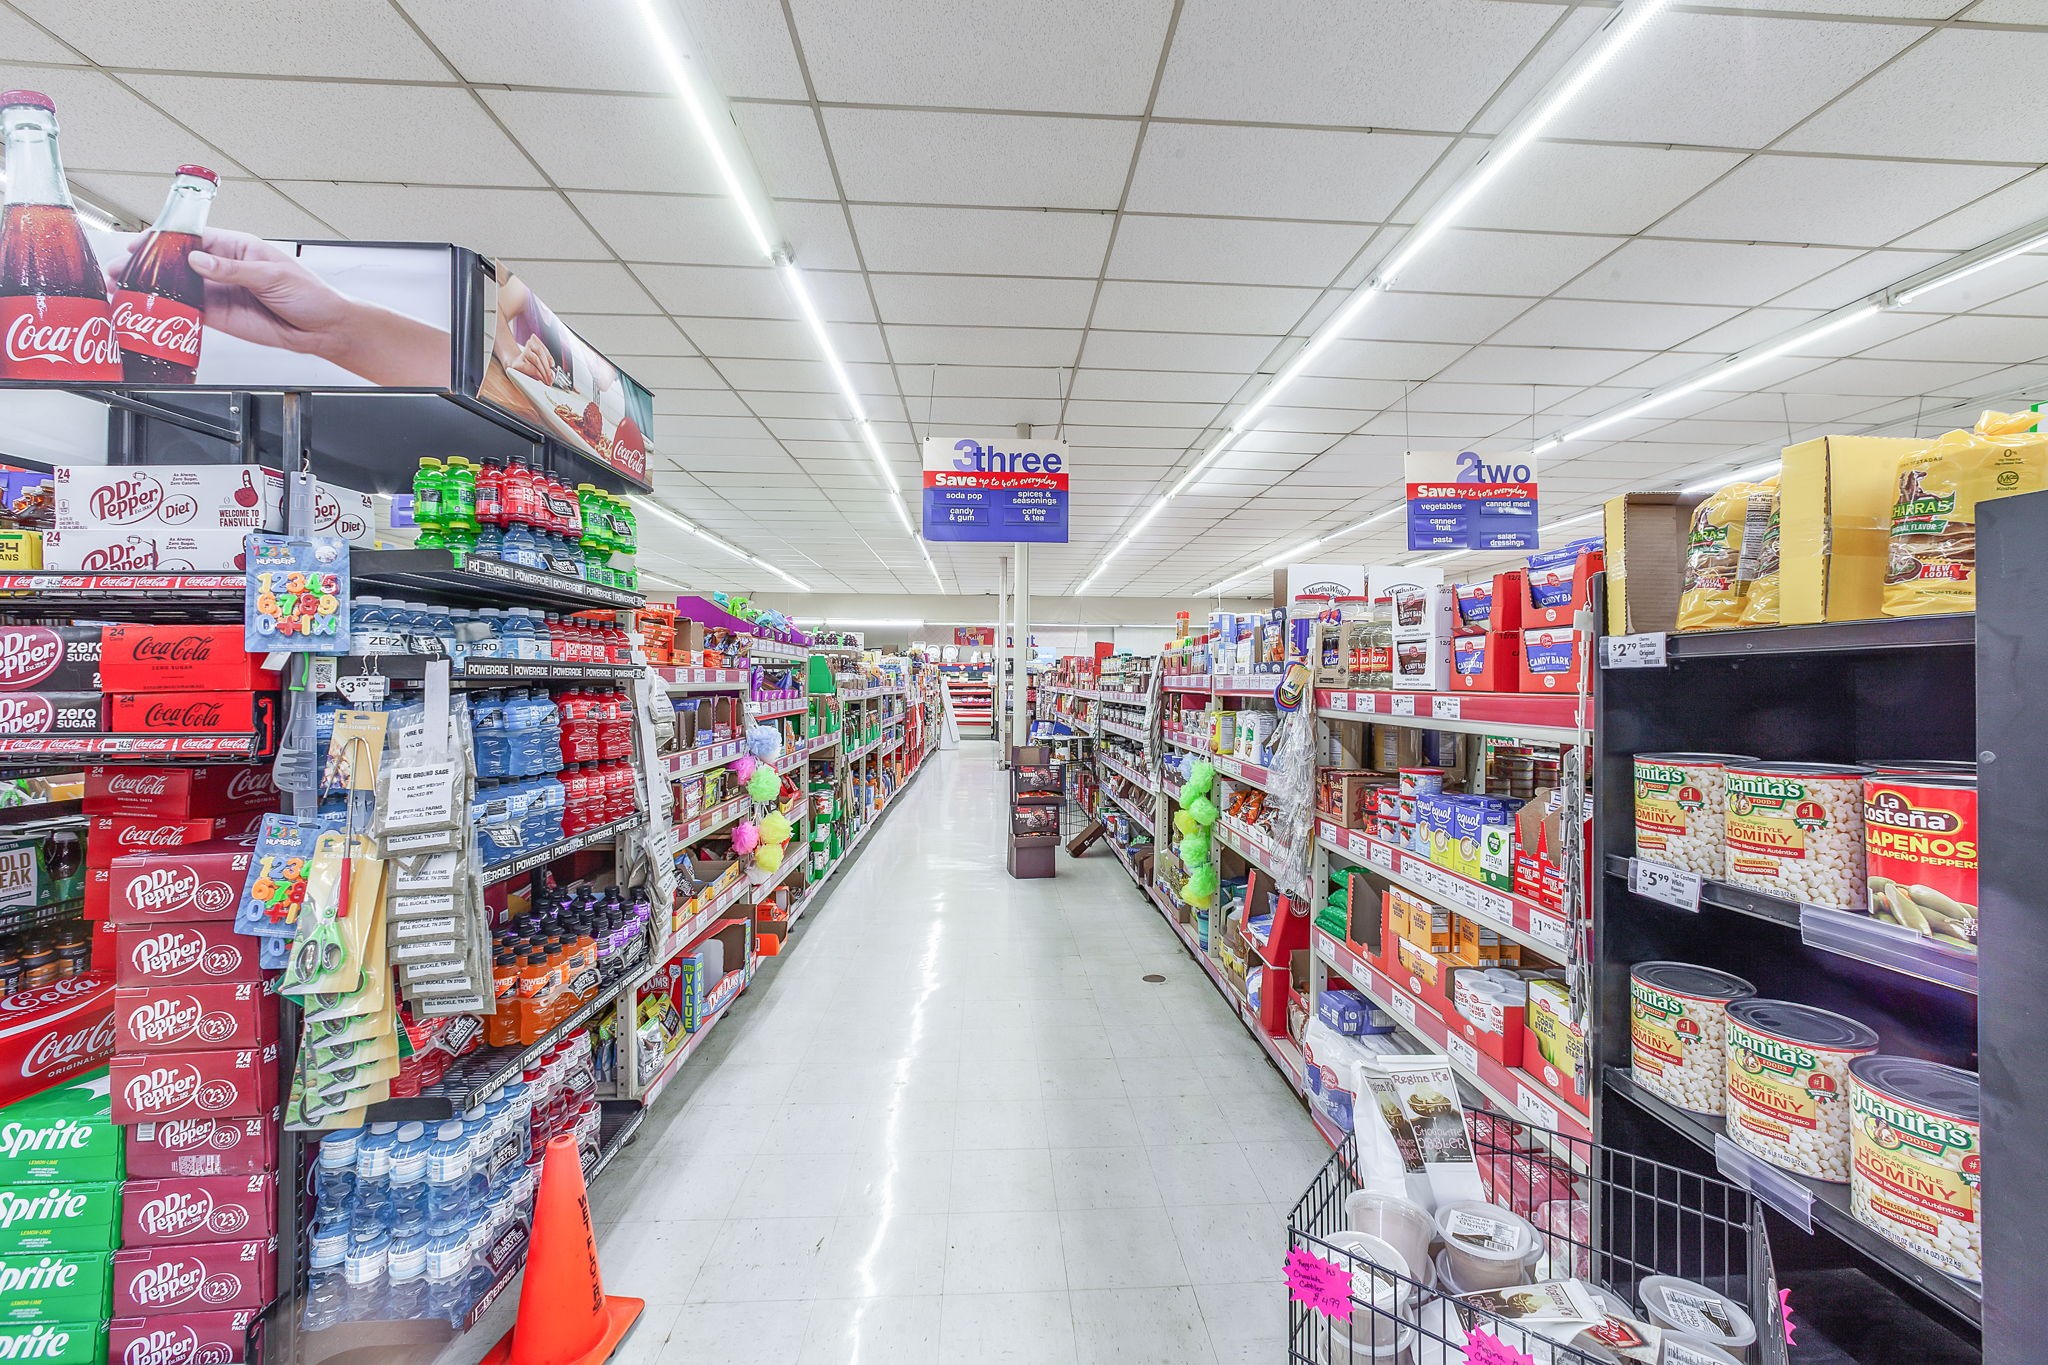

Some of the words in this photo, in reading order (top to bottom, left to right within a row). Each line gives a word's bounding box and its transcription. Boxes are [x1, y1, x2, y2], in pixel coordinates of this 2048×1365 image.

[111, 302, 201, 357] Coca-Cola
[6, 313, 121, 365] Coca-Cola
[613, 440, 646, 474] Coca-Cola
[57, 468, 70, 479] 24
[935, 473, 977, 487] Save
[978, 478, 990, 488] up
[991, 477, 1000, 486] to
[1001, 478, 1019, 487] 40%
[1020, 475, 1058, 490] everyday
[115, 480, 142, 501] Dr
[967, 493, 983, 501] pop
[1017, 491, 1043, 499] spices
[1417, 485, 1456, 497] Save
[1457, 489, 1467, 499] up
[1468, 488, 1476, 496] to
[1477, 489, 1493, 498] 40%
[1494, 485, 1528, 499] everyday
[90, 485, 159, 521] Pepper
[1012, 497, 1057, 506] seasonings
[1420, 503, 1463, 511] vegetables
[165, 502, 191, 519] Diet
[219, 510, 250, 518] WELCOME
[250, 510, 260, 518] TO
[949, 514, 956, 522] &
[957, 515, 975, 523] gum
[950, 507, 974, 516] candy
[1024, 514, 1031, 522] &
[219, 518, 260, 527] FANSVILLE
[341, 519, 361, 533] Diet
[46, 531, 61, 543] 24
[1432, 537, 1453, 545] pasta
[1490, 539, 1525, 548] dressings
[1924, 570, 1953, 578] LOOK!
[109, 629, 125, 637] 24
[133, 636, 215, 662] Coca-Cola
[472, 643, 498, 651] ZERO
[468, 664, 509, 676] POWERADE
[1529, 656, 1550, 667] CANDY
[1551, 656, 1570, 666] BARK
[514, 665, 549, 677] POWERADE
[552, 667, 582, 677] POWERADE
[120, 695, 135, 703] 24
[57, 708, 97, 719] zero
[145, 703, 221, 728] Coca-Cola
[57, 719, 96, 728] SUGAR
[108, 773, 169, 796] Coca-Cola
[1725, 772, 1802, 798] Juanita's
[1752, 798, 1777, 806] FOODS
[1879, 795, 1899, 810] La
[1431, 806, 1452, 823] equal
[1801, 804, 1815, 818] #1
[1864, 803, 1947, 831] Costeña
[99, 818, 112, 826] 24
[1456, 812, 1481, 829] equal
[118, 825, 188, 847] Coca-Cola
[1727, 824, 1792, 845] HOMINY
[1756, 825, 1784, 834] STYLE
[1766, 847, 1799, 857] Auténtico
[1865, 827, 1976, 860] LAPEÑOS
[232, 854, 247, 865] 24
[516, 852, 551, 871] POWERADE
[1485, 854, 1503, 867] STEVIA
[1871, 845, 1919, 863] JALAPEÑO
[1920, 856, 1978, 870] PEPPERS
[154, 868, 179, 889] Dr
[126, 875, 194, 911] Pepper
[204, 889, 222, 905] 23
[159, 932, 184, 951] Dr
[132, 938, 200, 974] Pepper
[211, 952, 229, 967] 23
[235, 984, 251, 995] 24
[155, 1000, 180, 1018] Dr
[684, 973, 694, 1028] VALUE
[128, 1004, 196, 1042] Pepper
[561, 1011, 592, 1037] POWERADE
[1535, 1021, 1557, 1040] STARCH
[1537, 1016, 1554, 1031] CORN
[524, 1037, 559, 1067] POWERADE
[1727, 1023, 1813, 1068] Juanita's
[236, 1052, 251, 1064] 24
[1762, 1059, 1788, 1072] FOODS
[47, 1056, 95, 1078] ORIGINAL
[151, 1066, 176, 1087] Dr
[1392, 1072, 1430, 1085] Regina
[1432, 1072, 1450, 1083] K's
[1812, 1076, 1826, 1089] #1
[125, 1074, 193, 1111] Pepper
[1731, 1074, 1805, 1114] HOMINY
[1767, 1088, 1795, 1100] STYLE
[1777, 1112, 1810, 1127] Auténtico
[1852, 1086, 1970, 1147] Juanita's
[0, 1119, 93, 1158] Sprite
[159, 1122, 212, 1150] Pepper
[1900, 1133, 1935, 1150] FOODS
[1526, 1164, 1545, 1180] SELF
[1858, 1147, 1957, 1200] HOMINY
[1864, 1145, 1904, 1172] MEXICAN
[1907, 1167, 1944, 1186] STYLE
[165, 1193, 190, 1211] Dr
[1883, 1180, 1920, 1202] Mexicano
[1921, 1198, 1965, 1218] Auténtico
[0, 1188, 88, 1229] Sprite
[139, 1198, 206, 1235] Pepper
[1883, 1199, 1931, 1222] PRESERVATIVES
[1881, 1206, 1935, 1233] CONSERVADORES
[156, 1263, 182, 1282] Dr
[130, 1268, 199, 1304] Pepper
[232, 1312, 248, 1325] 24
